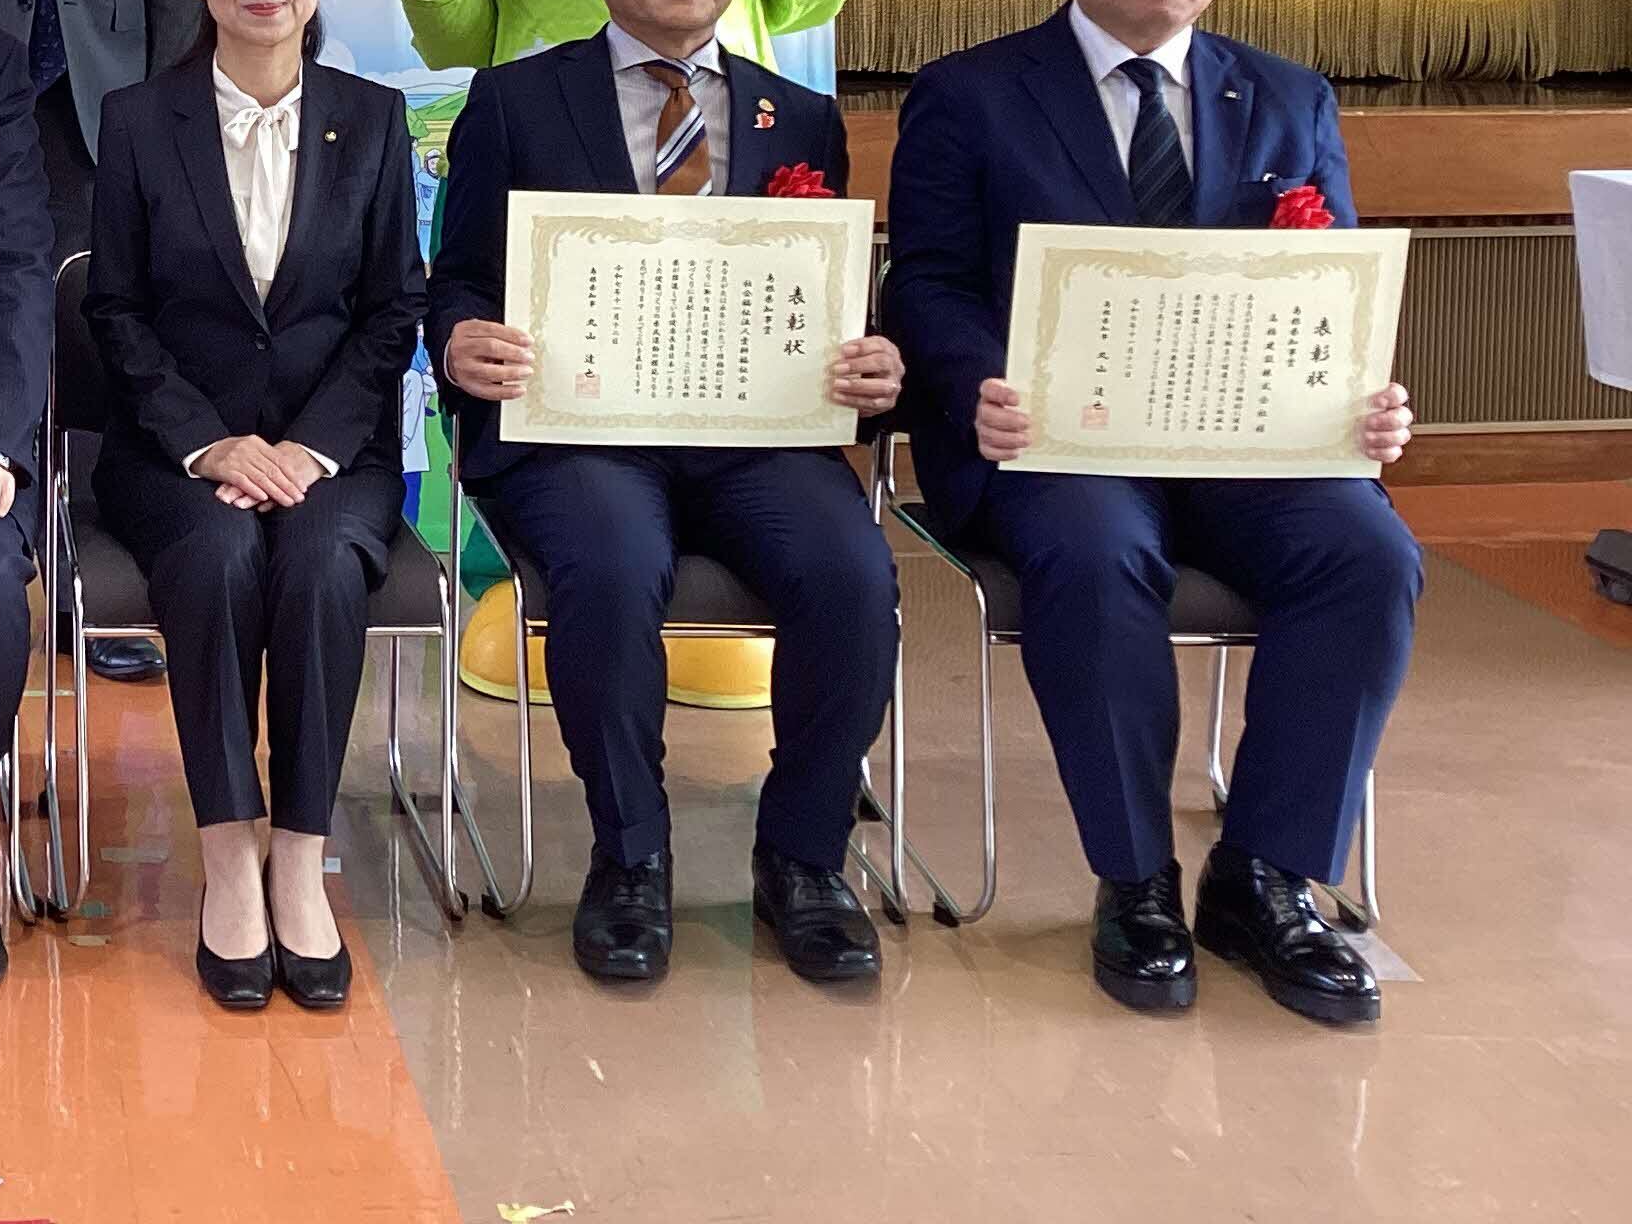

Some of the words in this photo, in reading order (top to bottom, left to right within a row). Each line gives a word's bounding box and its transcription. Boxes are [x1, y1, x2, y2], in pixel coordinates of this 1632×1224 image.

[784, 285, 806, 356] 表彰状
[1306, 317, 1332, 387] 表彰状
